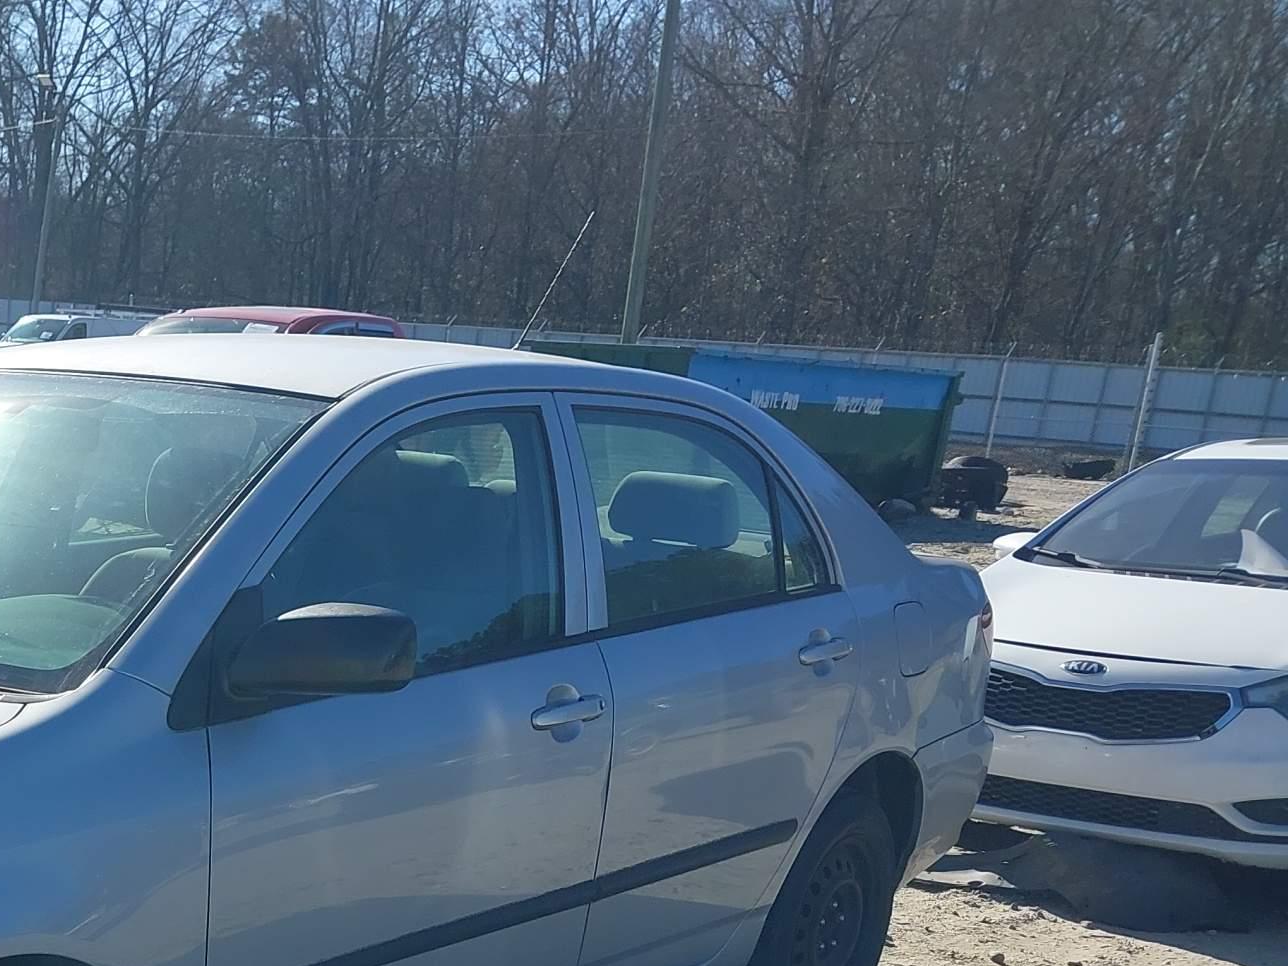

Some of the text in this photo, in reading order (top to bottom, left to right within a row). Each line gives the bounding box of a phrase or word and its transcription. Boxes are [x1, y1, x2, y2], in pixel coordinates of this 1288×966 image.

[751, 390, 800, 411] WASTE PRO
[1068, 661, 1099, 672] KIA
